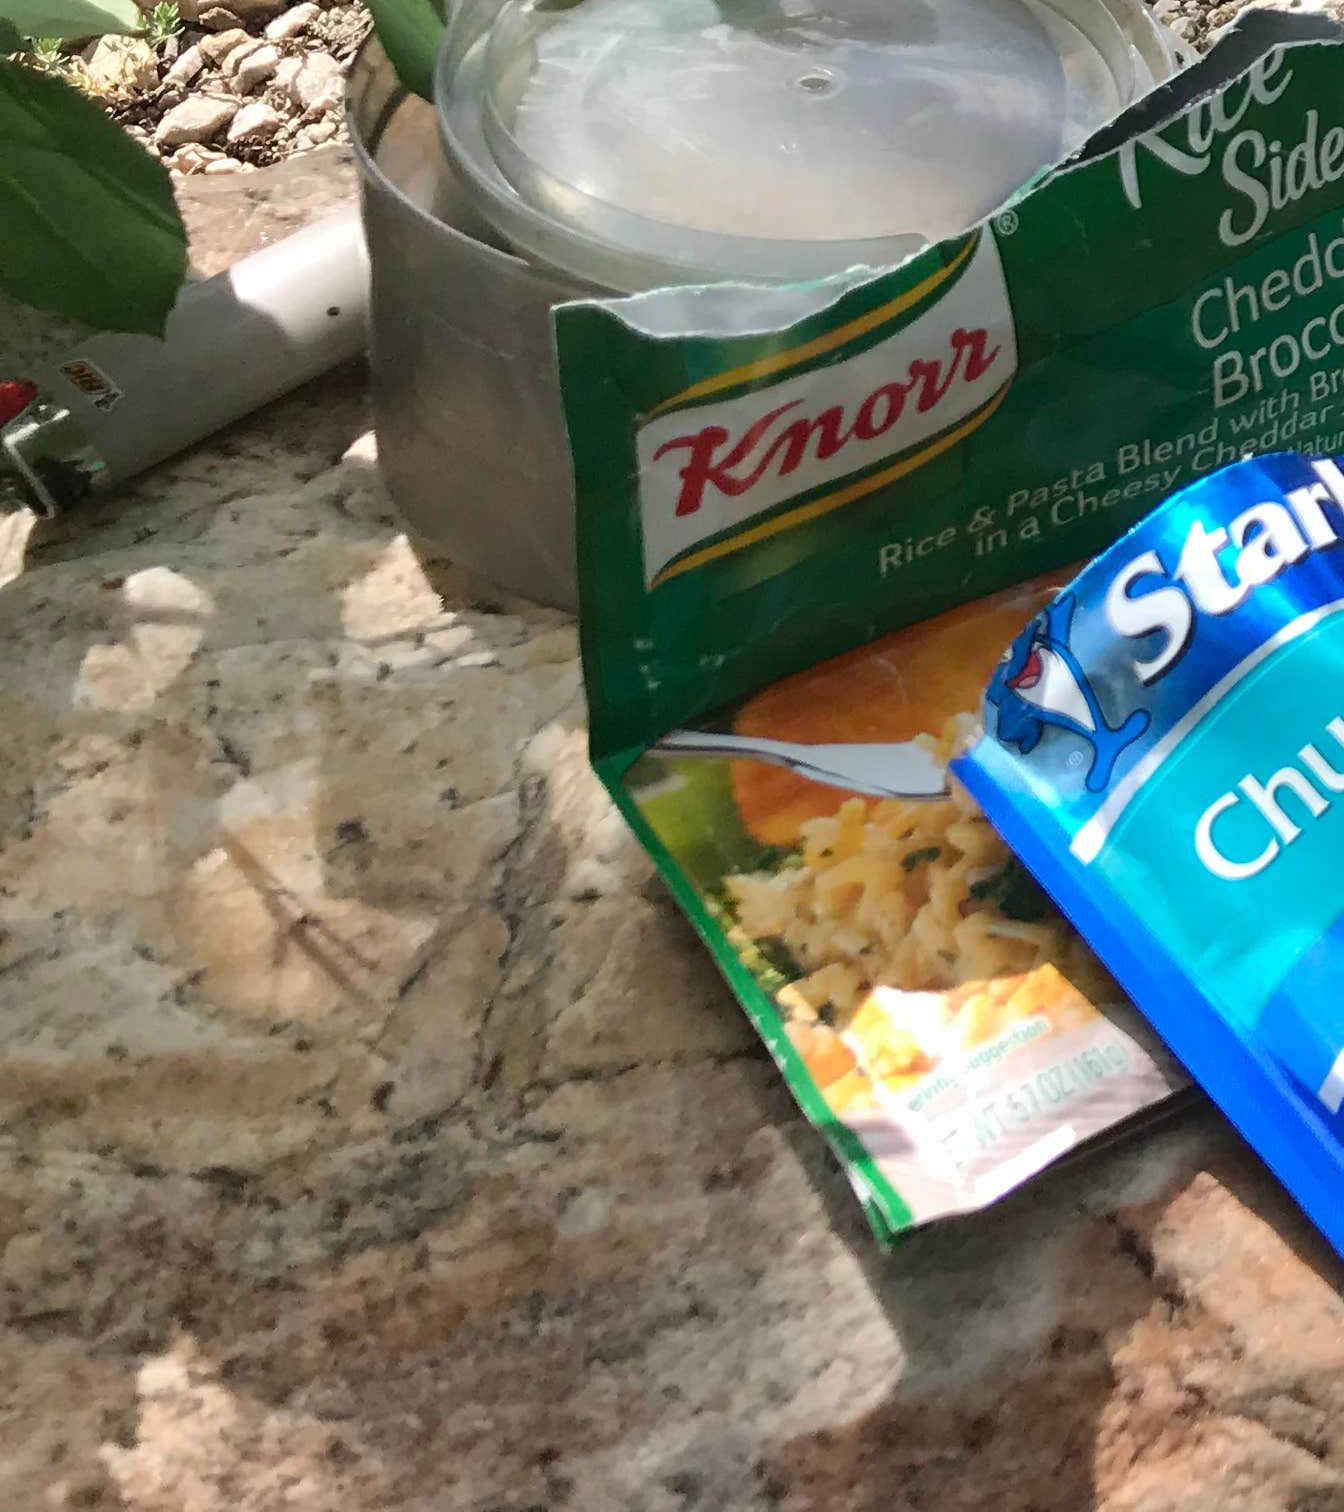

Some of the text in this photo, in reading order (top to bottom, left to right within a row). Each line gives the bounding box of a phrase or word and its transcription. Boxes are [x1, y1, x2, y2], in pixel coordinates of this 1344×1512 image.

[649, 328, 997, 518] Knorr
[878, 527, 956, 577] Rice
[967, 507, 997, 534] &
[1008, 461, 1106, 516] Pasta
[1118, 417, 1220, 475] Blend
[1228, 393, 1301, 441] with
[975, 528, 1009, 558] in
[1018, 519, 1041, 540] a
[1050, 467, 1184, 528] Cheesy
[1190, 405, 1329, 472] Cheddar
